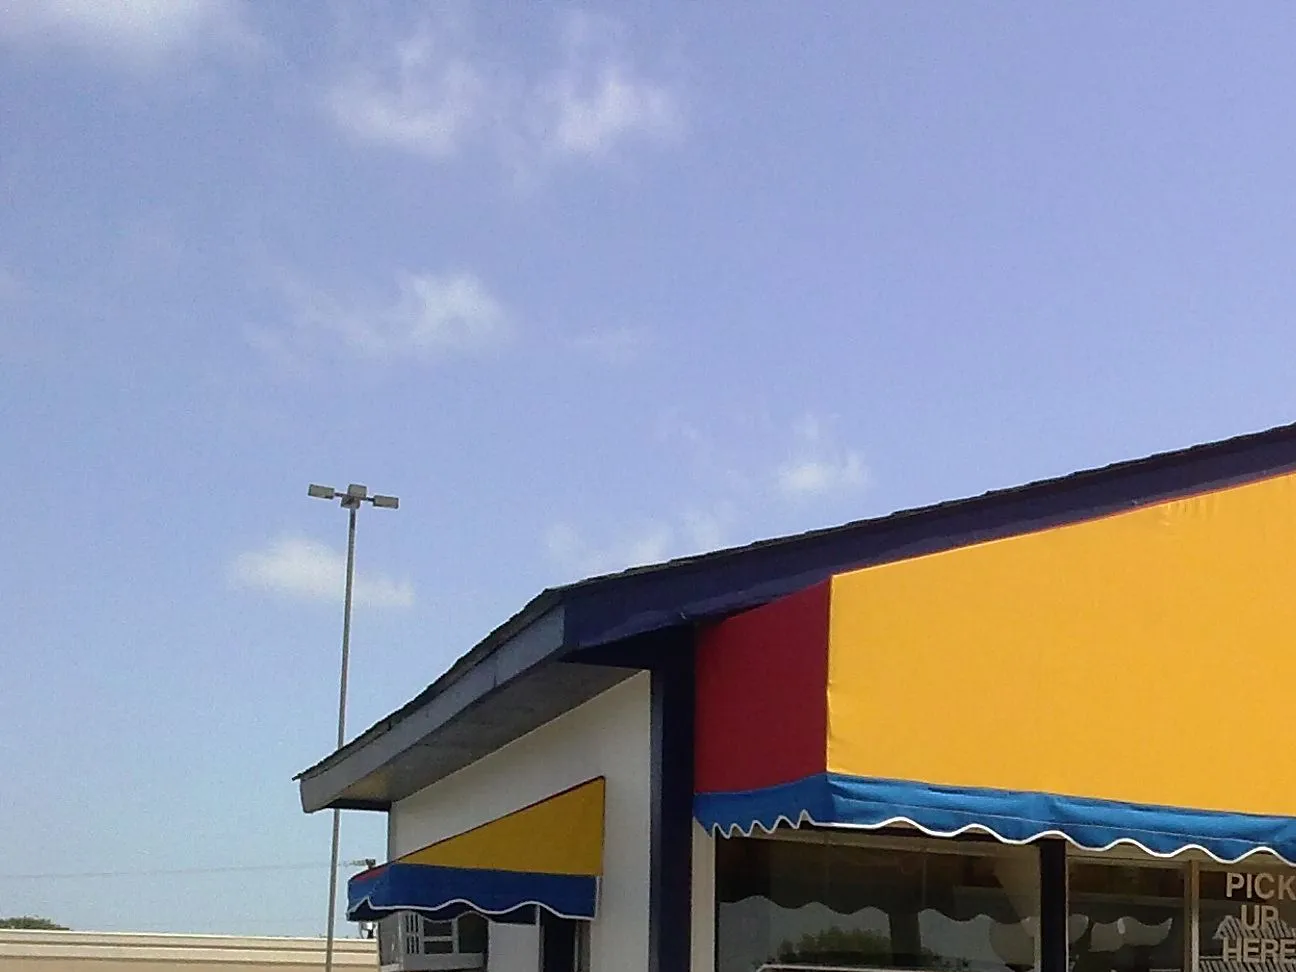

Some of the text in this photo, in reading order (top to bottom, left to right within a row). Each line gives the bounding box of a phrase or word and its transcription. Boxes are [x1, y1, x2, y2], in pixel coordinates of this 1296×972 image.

[1226, 872, 1296, 901] PICK
[1240, 904, 1279, 931] UP
[1222, 936, 1296, 964] HERE
